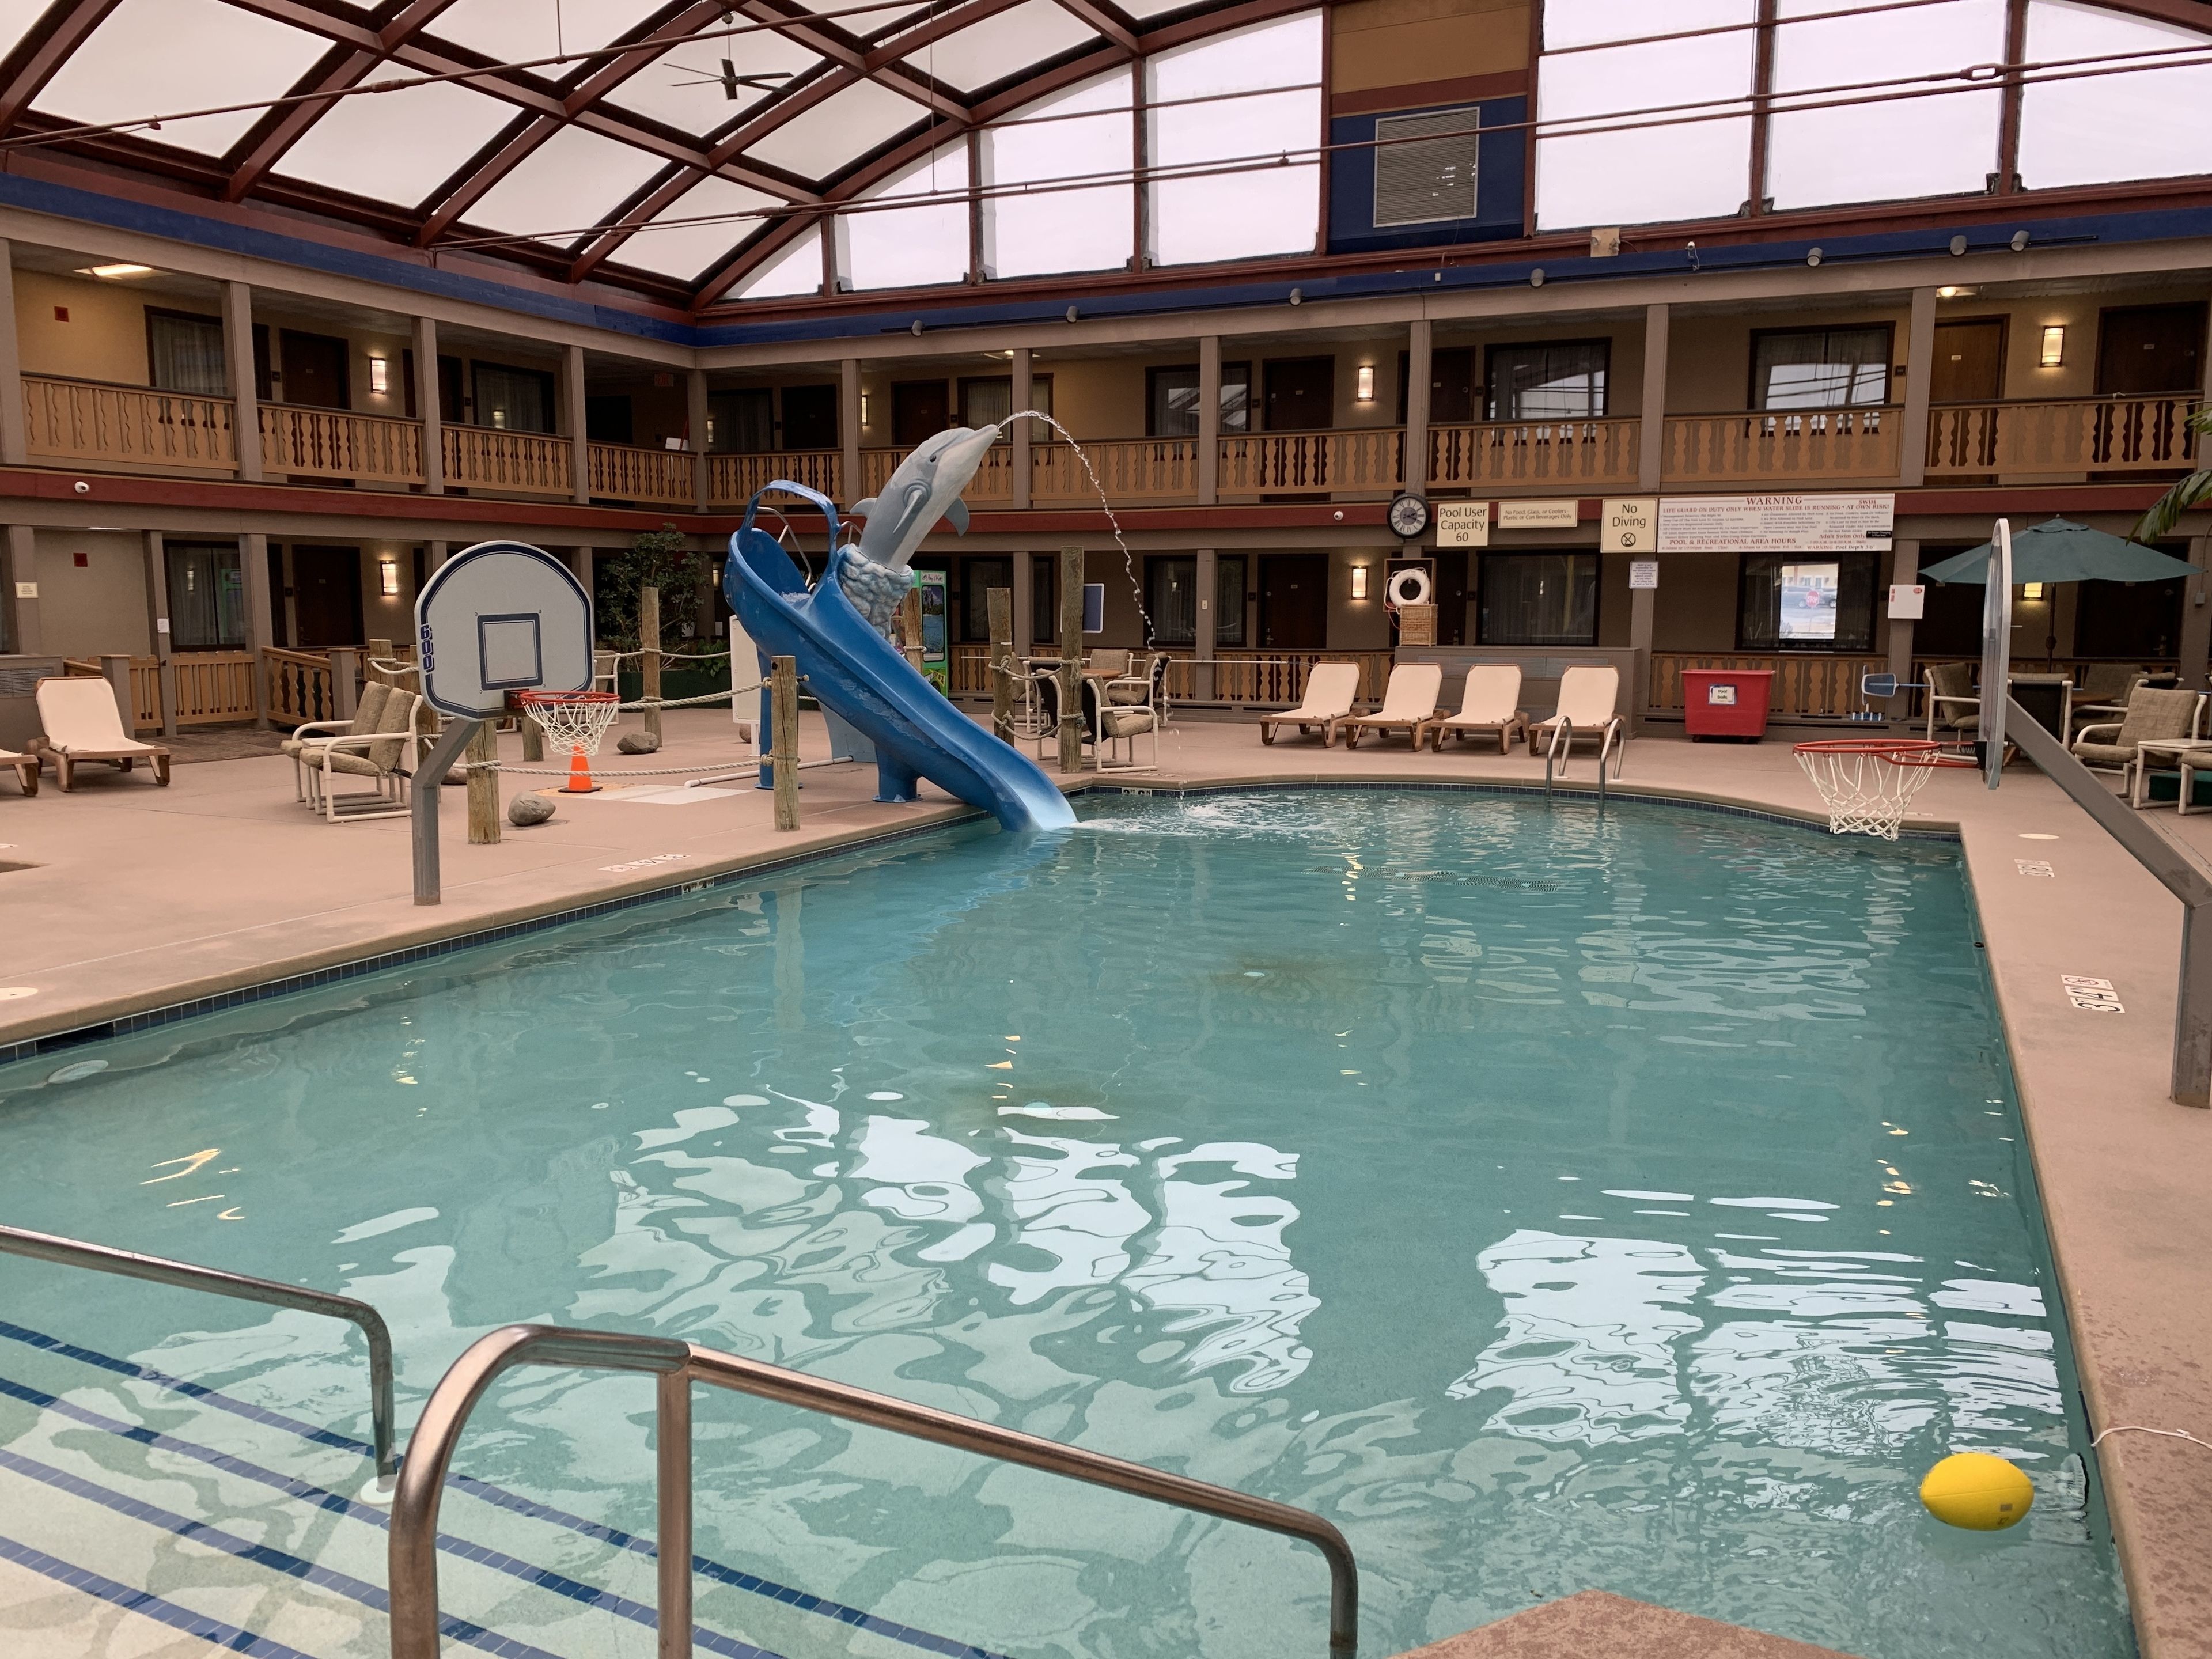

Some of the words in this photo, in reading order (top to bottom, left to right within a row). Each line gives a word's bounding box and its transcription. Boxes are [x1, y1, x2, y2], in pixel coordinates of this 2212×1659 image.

[1747, 497, 1802, 505] WARNING
[1440, 507, 1461, 517] Pool
[1465, 507, 1487, 517] User
[1622, 503, 1637, 514] No
[1441, 520, 1485, 532] Capacity
[1612, 516, 1646, 528] Diving
[1456, 532, 1468, 541] 60
[1807, 596, 1819, 604] STOP
[2071, 991, 2113, 1000] 4
[2077, 1003, 2121, 1012] 3
